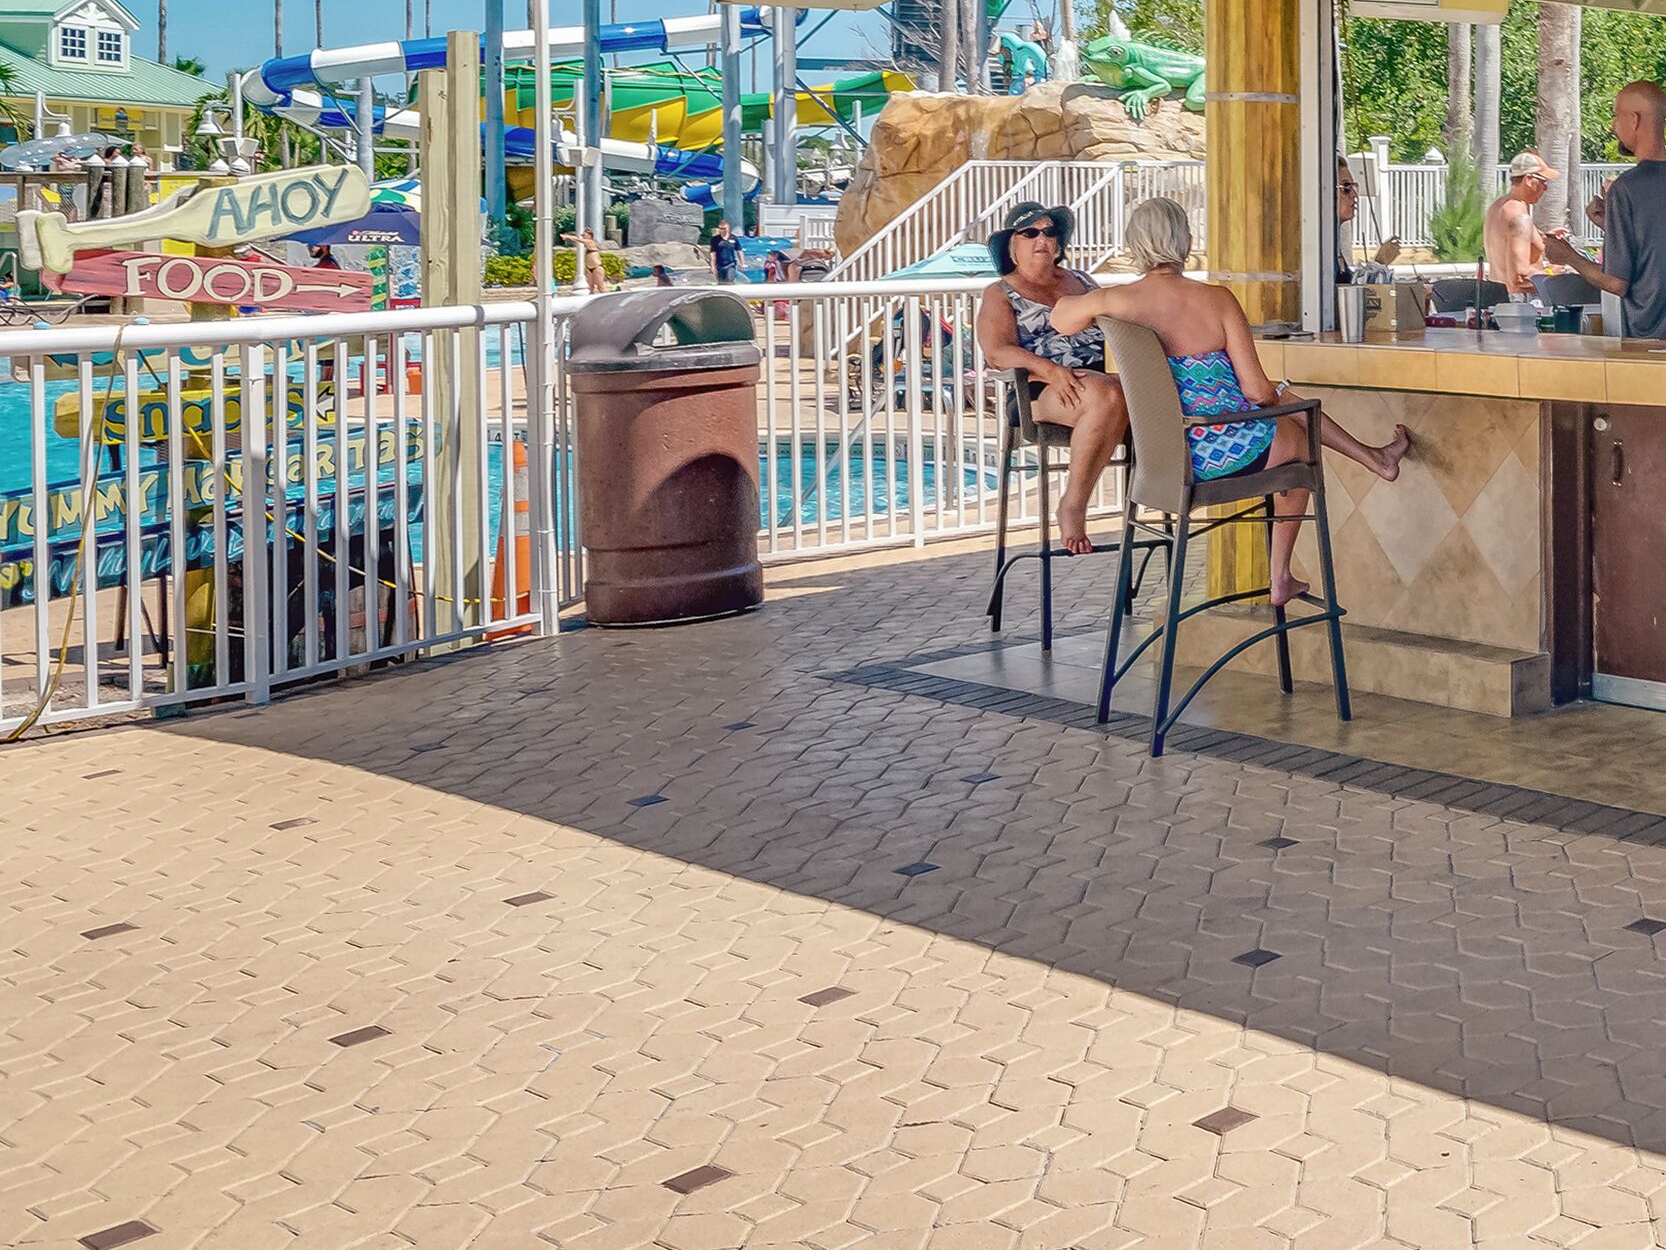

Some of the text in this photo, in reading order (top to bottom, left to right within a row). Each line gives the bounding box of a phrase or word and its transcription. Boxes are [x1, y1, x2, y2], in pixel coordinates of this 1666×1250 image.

[207, 167, 349, 240] AHOY
[347, 234, 406, 243] ULTRA
[122, 257, 294, 302] FOOD
[103, 386, 305, 442] Snacs
